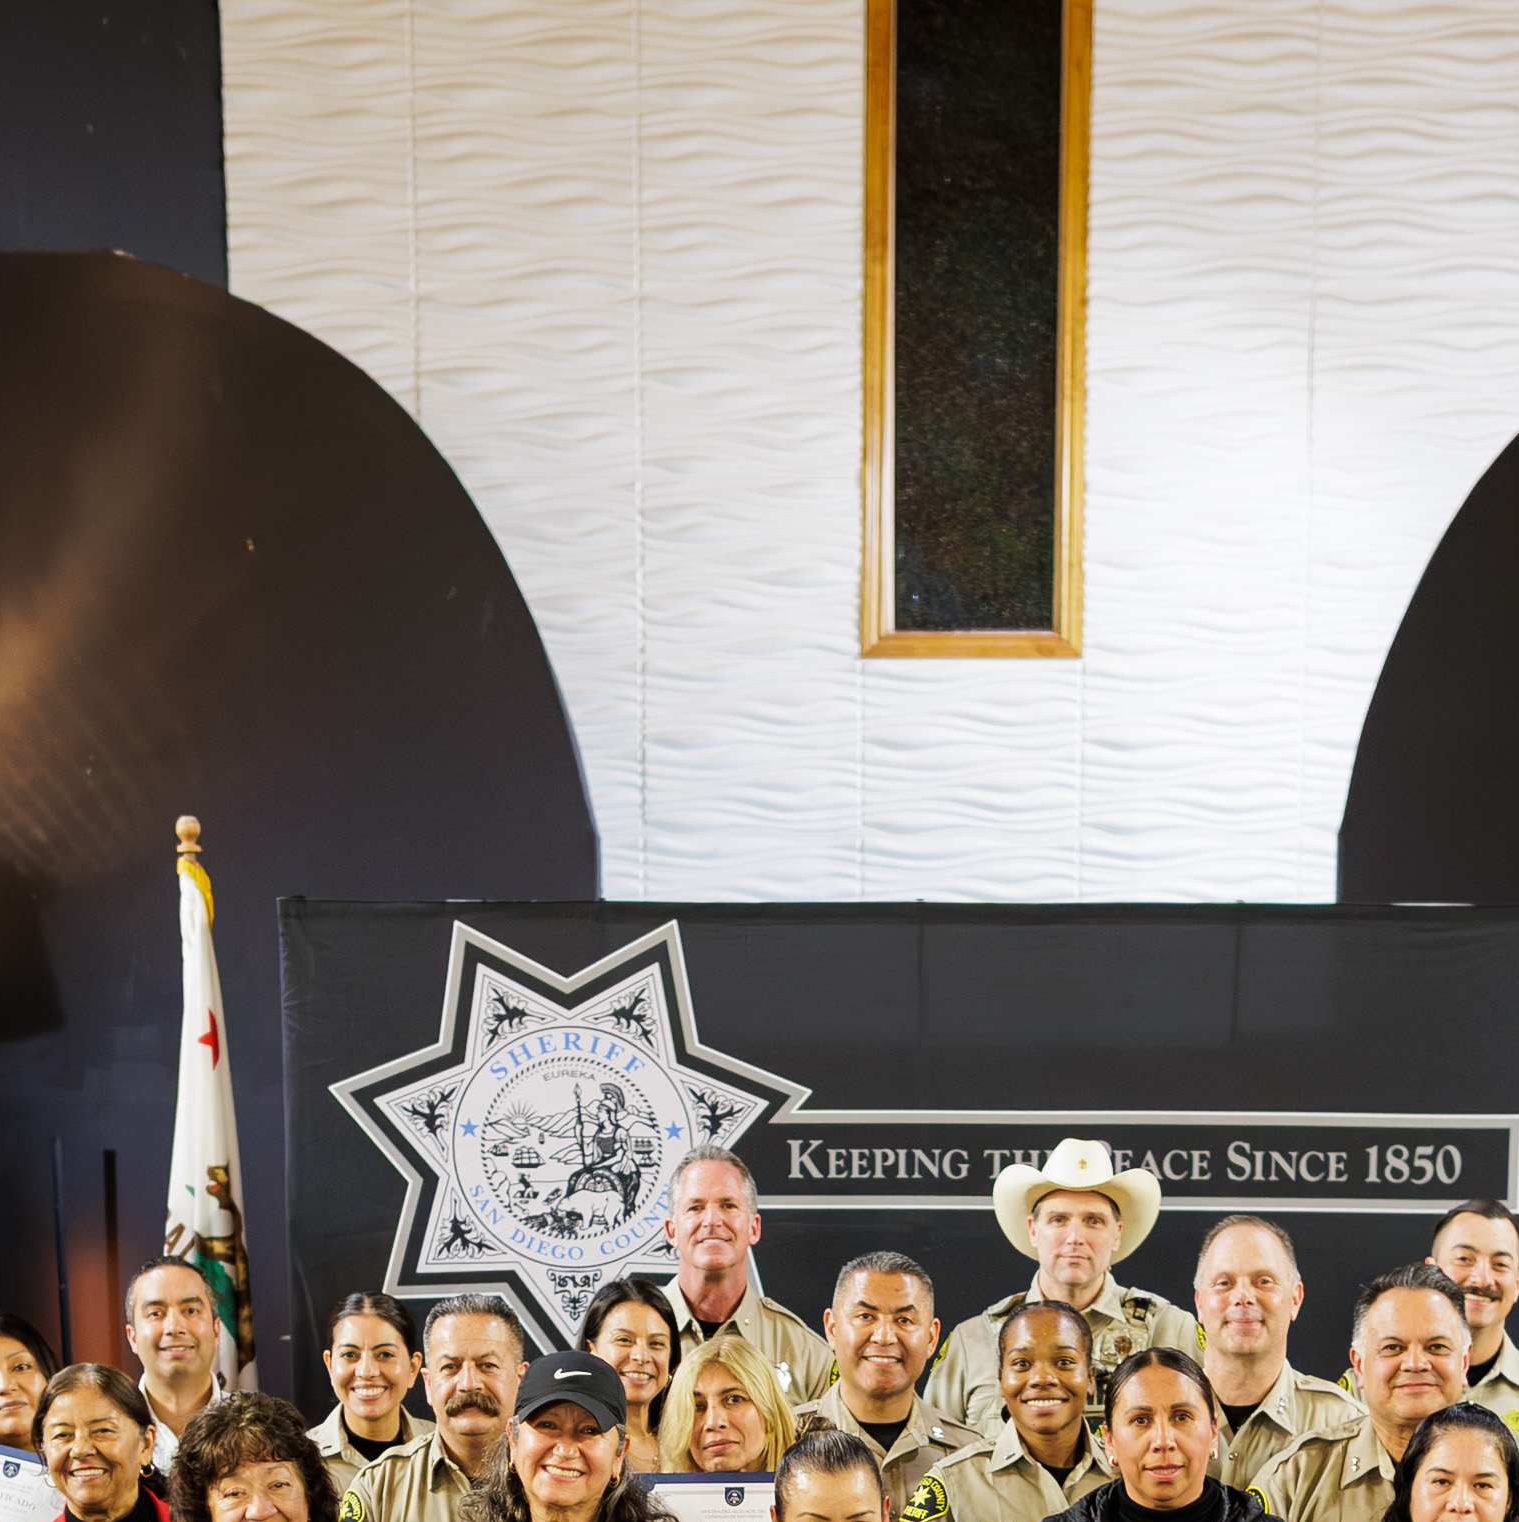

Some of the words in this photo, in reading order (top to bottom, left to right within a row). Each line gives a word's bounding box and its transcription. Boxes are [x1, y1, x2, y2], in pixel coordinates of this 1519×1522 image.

[489, 1032, 646, 1081] SHERIFF
[542, 1070, 596, 1082] EUREKA
[983, 1150, 1053, 1179] TH
[1364, 1145, 1463, 1184] 1850
[469, 1184, 504, 1225] SAN
[510, 1228, 584, 1260] DIEGO
